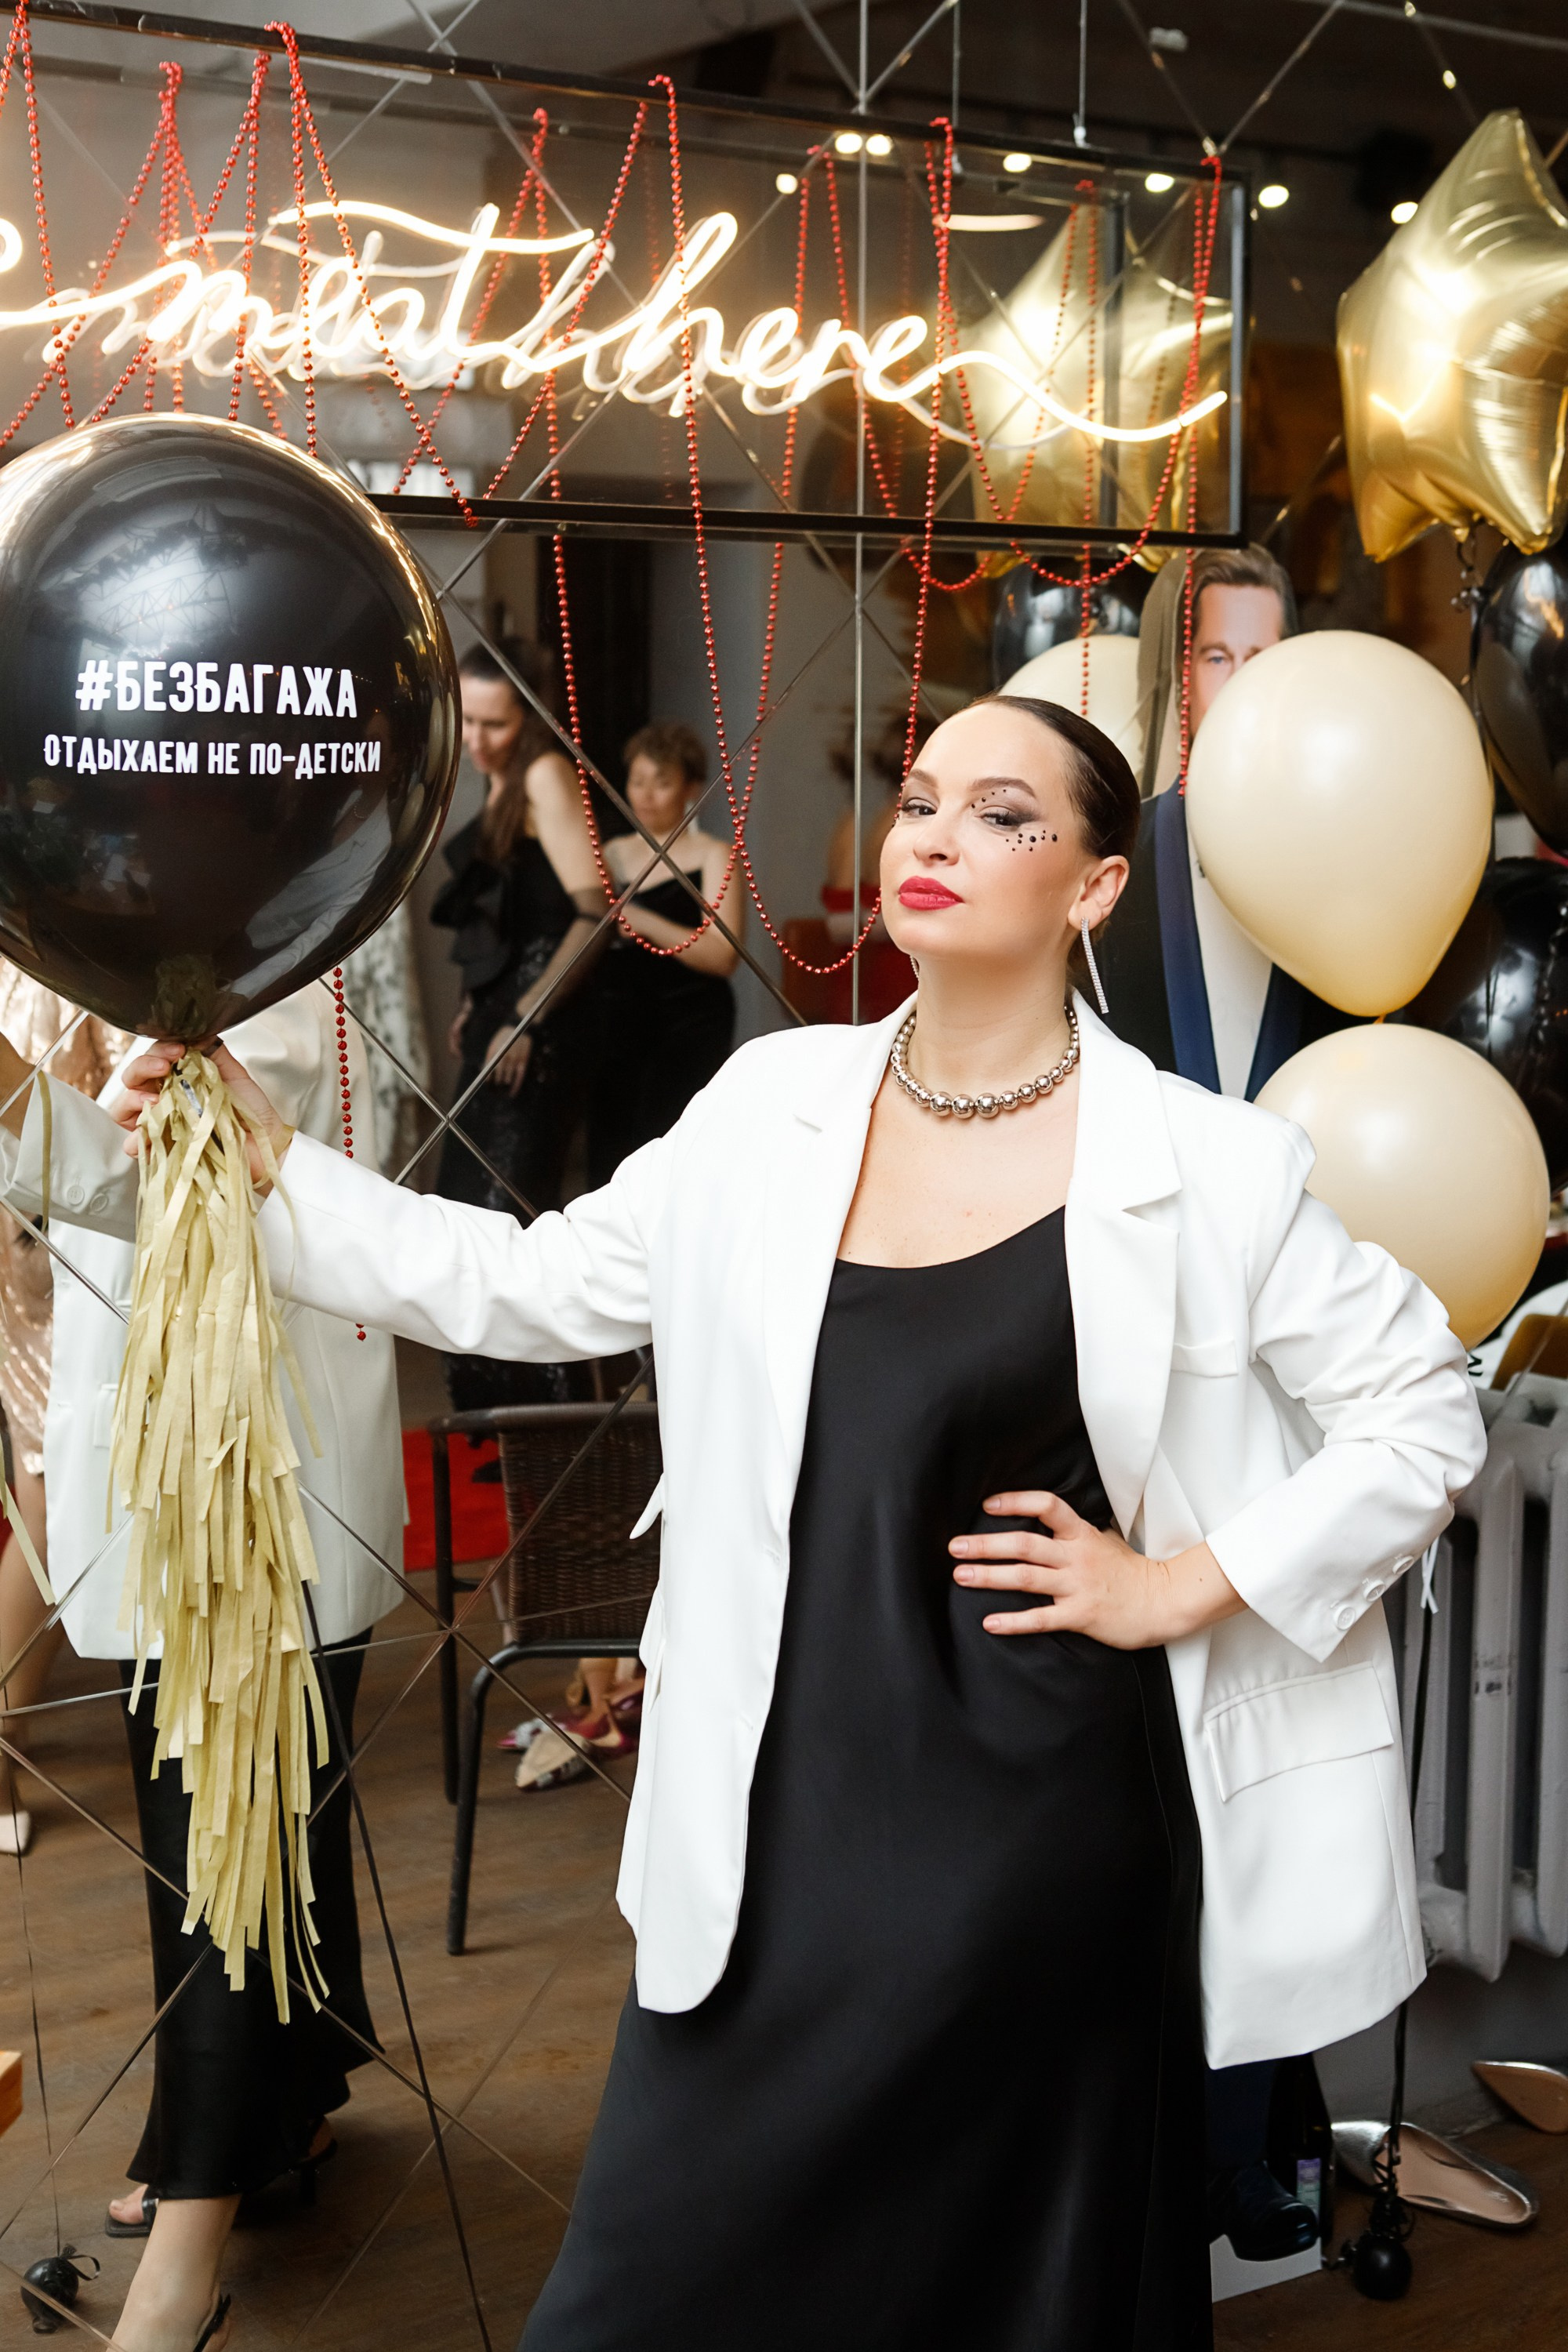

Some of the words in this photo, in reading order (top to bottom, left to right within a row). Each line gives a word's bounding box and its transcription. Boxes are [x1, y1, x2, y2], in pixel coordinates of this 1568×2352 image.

[600, 210, 1043, 417] here
[74, 659, 358, 718] #БЕЗБАГАЖА
[42, 733, 199, 775] ОТДЫХАЕМ
[207, 741, 241, 775] НЕ
[249, 740, 382, 780] ПО-ДЕТСКИ
